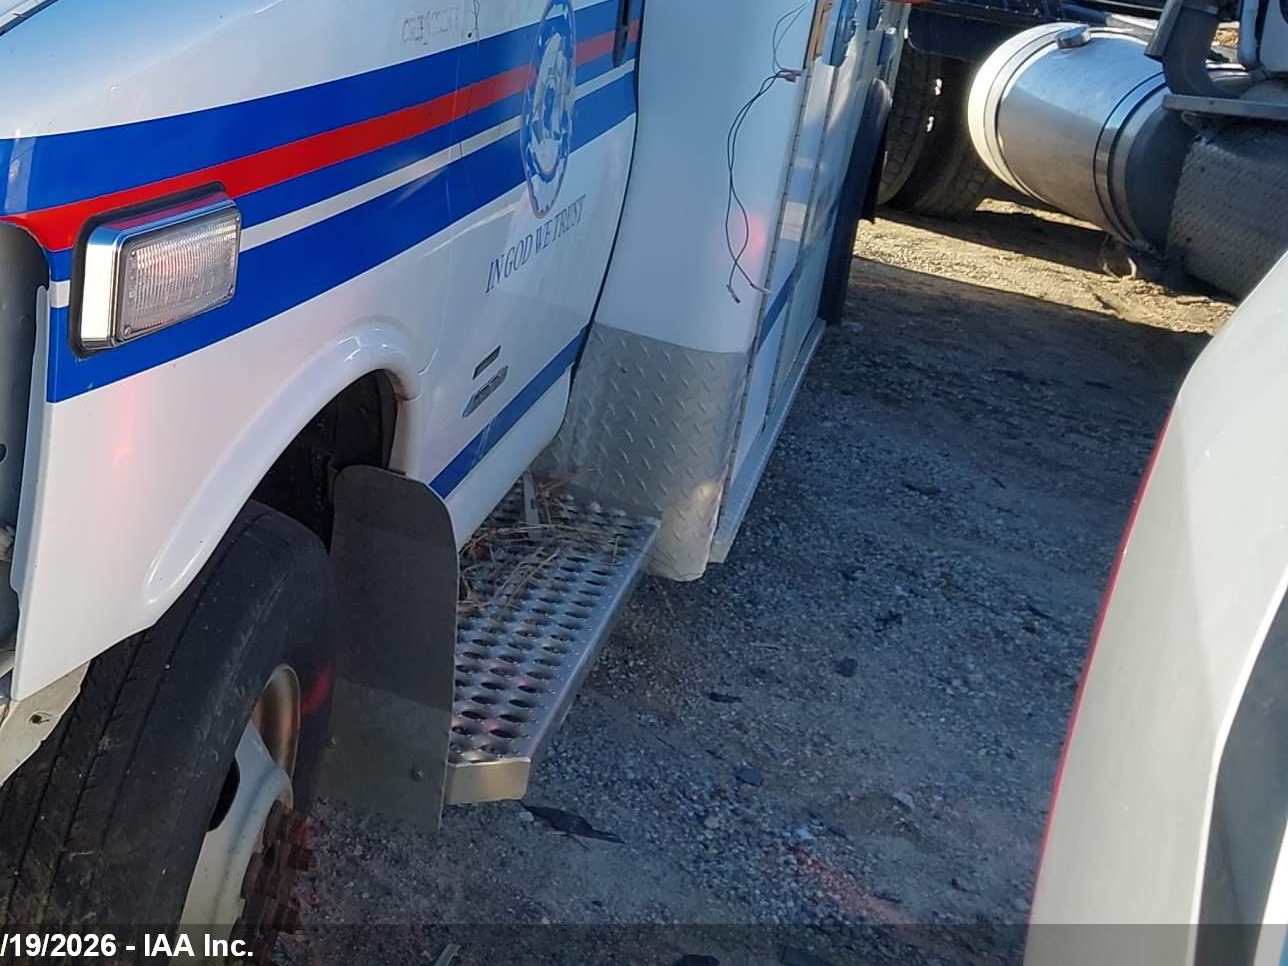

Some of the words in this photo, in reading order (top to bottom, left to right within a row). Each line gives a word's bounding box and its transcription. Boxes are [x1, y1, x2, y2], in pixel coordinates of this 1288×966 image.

[485, 253, 505, 294] IN
[504, 233, 533, 279] GOD
[535, 219, 553, 254] WE
[552, 194, 587, 242] TRUST
